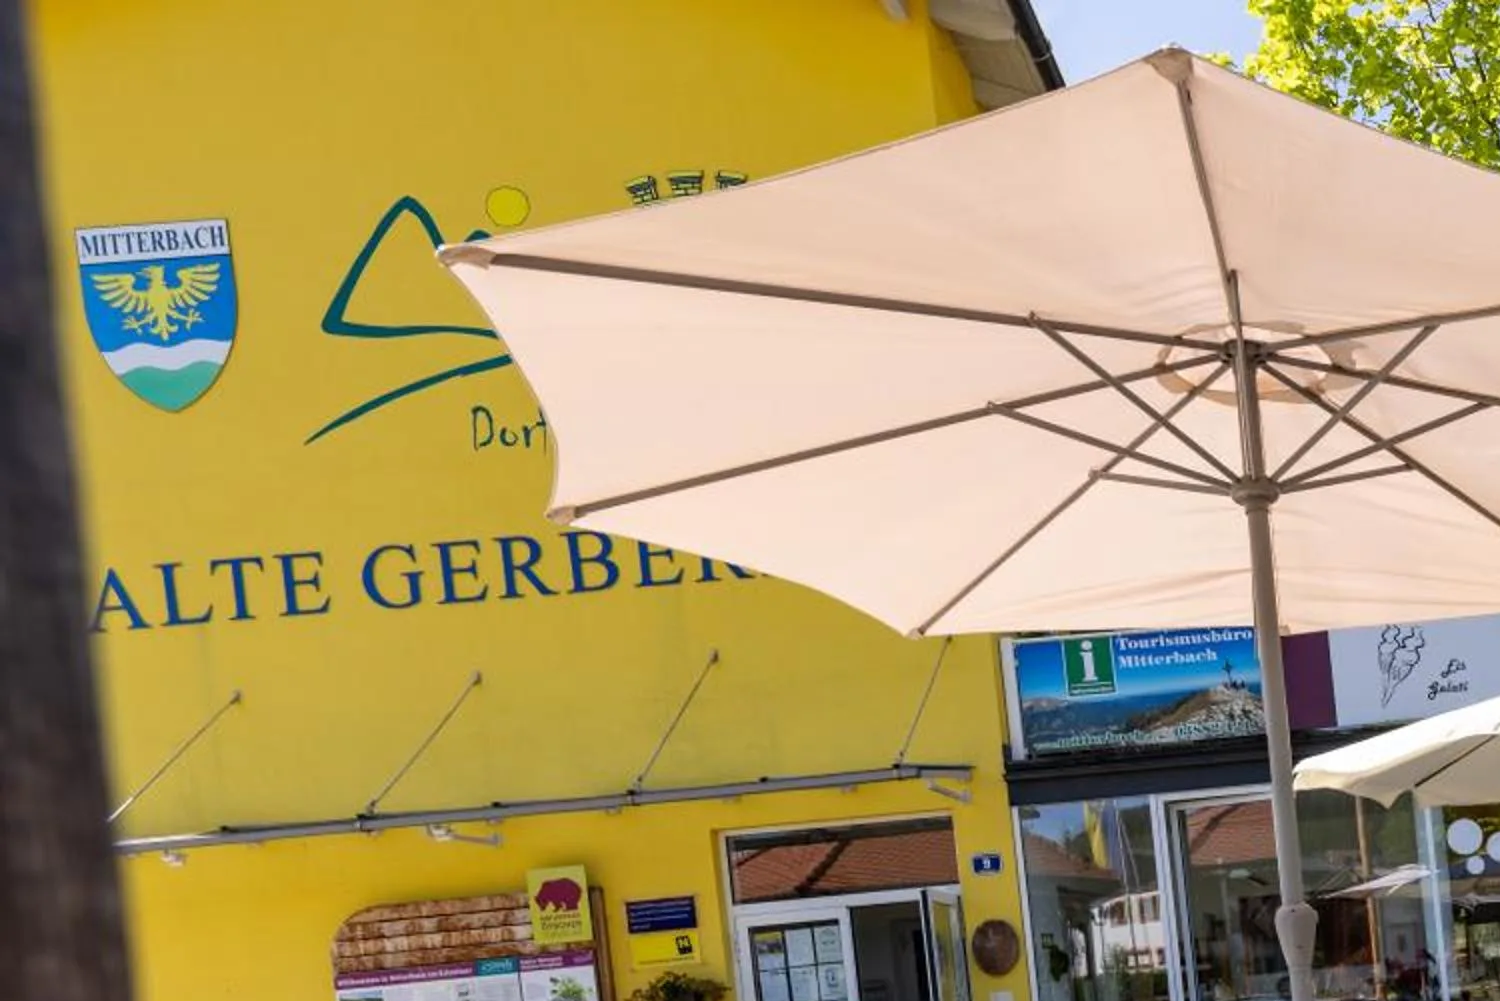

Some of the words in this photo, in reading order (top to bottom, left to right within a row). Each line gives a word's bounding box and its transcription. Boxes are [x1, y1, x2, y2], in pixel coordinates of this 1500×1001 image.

[80, 225, 226, 258] MITTERBACH
[86, 550, 332, 634] ALTE
[1116, 628, 1252, 651] Tourismusbüro
[1117, 649, 1218, 669] Mitterbach
[1427, 680, 1469, 700] Gelati
